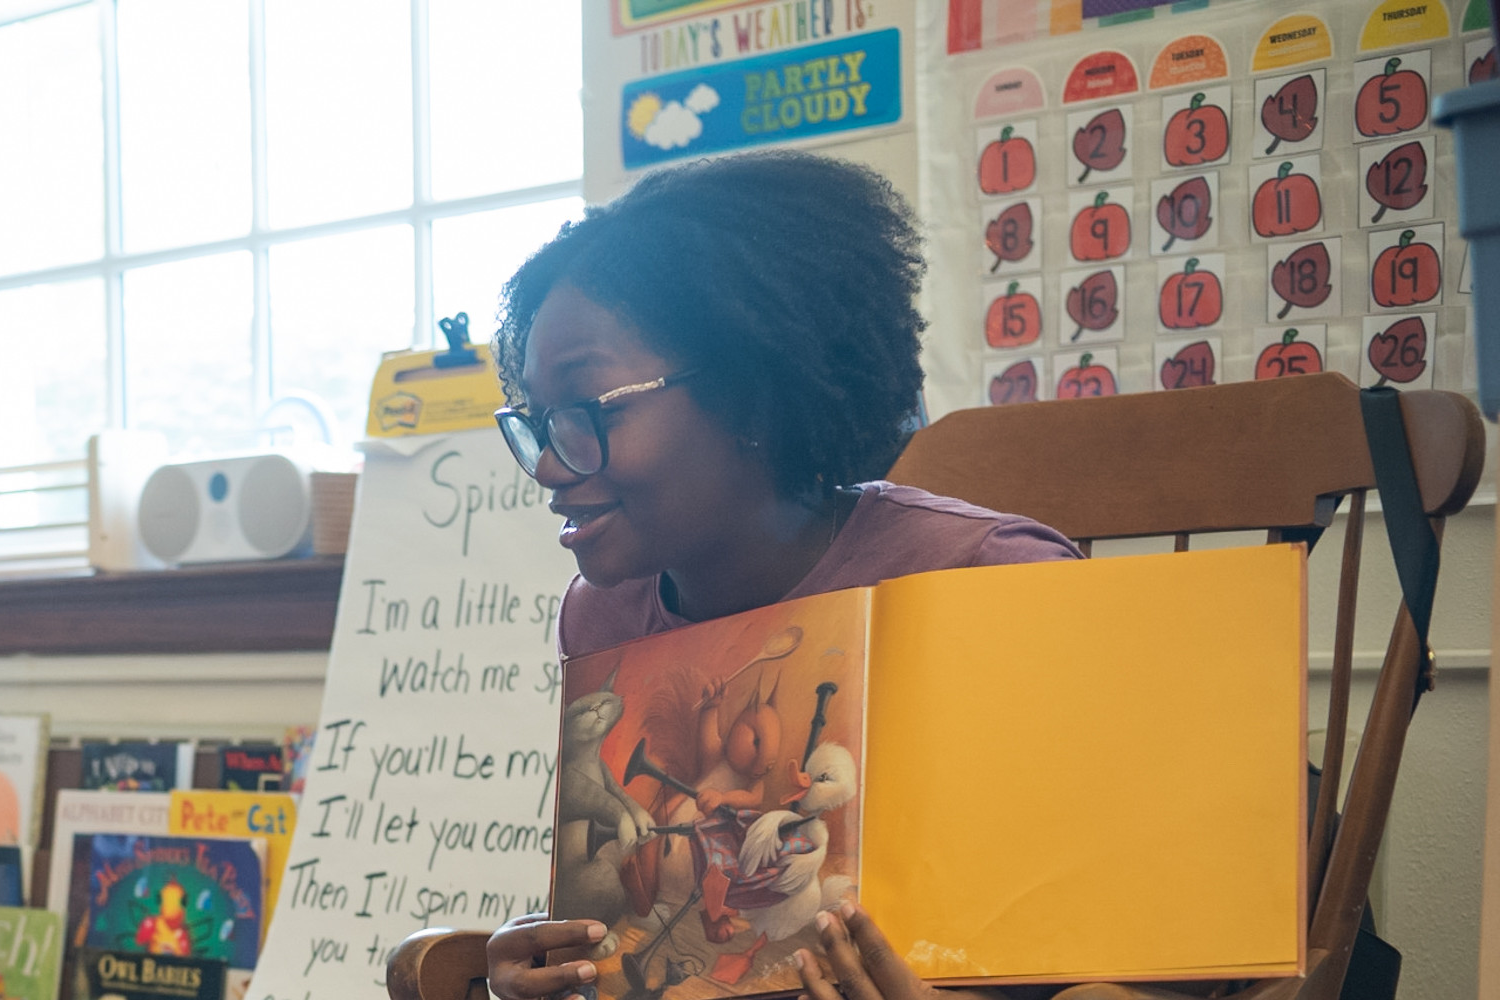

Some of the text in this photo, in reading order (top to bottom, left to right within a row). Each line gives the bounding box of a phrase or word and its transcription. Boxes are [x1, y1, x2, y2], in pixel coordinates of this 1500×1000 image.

[1382, 5, 1428, 22] THURSDAY
[640, 19, 722, 73] TODAY'S
[734, 0, 835, 53] WEATHER
[1268, 26, 1317, 45] WEDNESDAY
[1171, 48, 1204, 62] TUESDAY
[745, 51, 866, 100] PARTLY
[741, 82, 871, 134] CLOUDY
[1278, 93, 1299, 129] 4
[1378, 84, 1402, 124] 5
[1088, 124, 1107, 160] 2
[1185, 119, 1206, 155] 3
[1384, 157, 1413, 196] 12
[1168, 193, 1200, 229] 10
[1276, 188, 1291, 224] 11
[1002, 217, 1019, 252] 8
[1091, 218, 1108, 251] 9
[1290, 259, 1317, 295] 18
[1390, 257, 1419, 295] 19
[1080, 285, 1107, 321] 16
[1176, 281, 1205, 318] 17
[1002, 303, 1027, 338] 15
[1266, 355, 1308, 377] 25
[1380, 333, 1420, 369] 26
[1172, 357, 1208, 390] 24
[357, 580, 409, 635] I'm
[422, 596, 440, 630] a
[456, 578, 521, 629] little
[481, 662, 520, 694] me
[317, 719, 559, 819] If you'll be my
[180, 799, 288, 836] Pete Cat
[311, 795, 553, 872] I'll let you come
[290, 857, 348, 910] Then
[355, 871, 407, 918] I'll
[410, 886, 468, 929] spin
[478, 892, 516, 926] my
[98, 954, 202, 988] OWL BABIES
[303, 936, 348, 978] you
